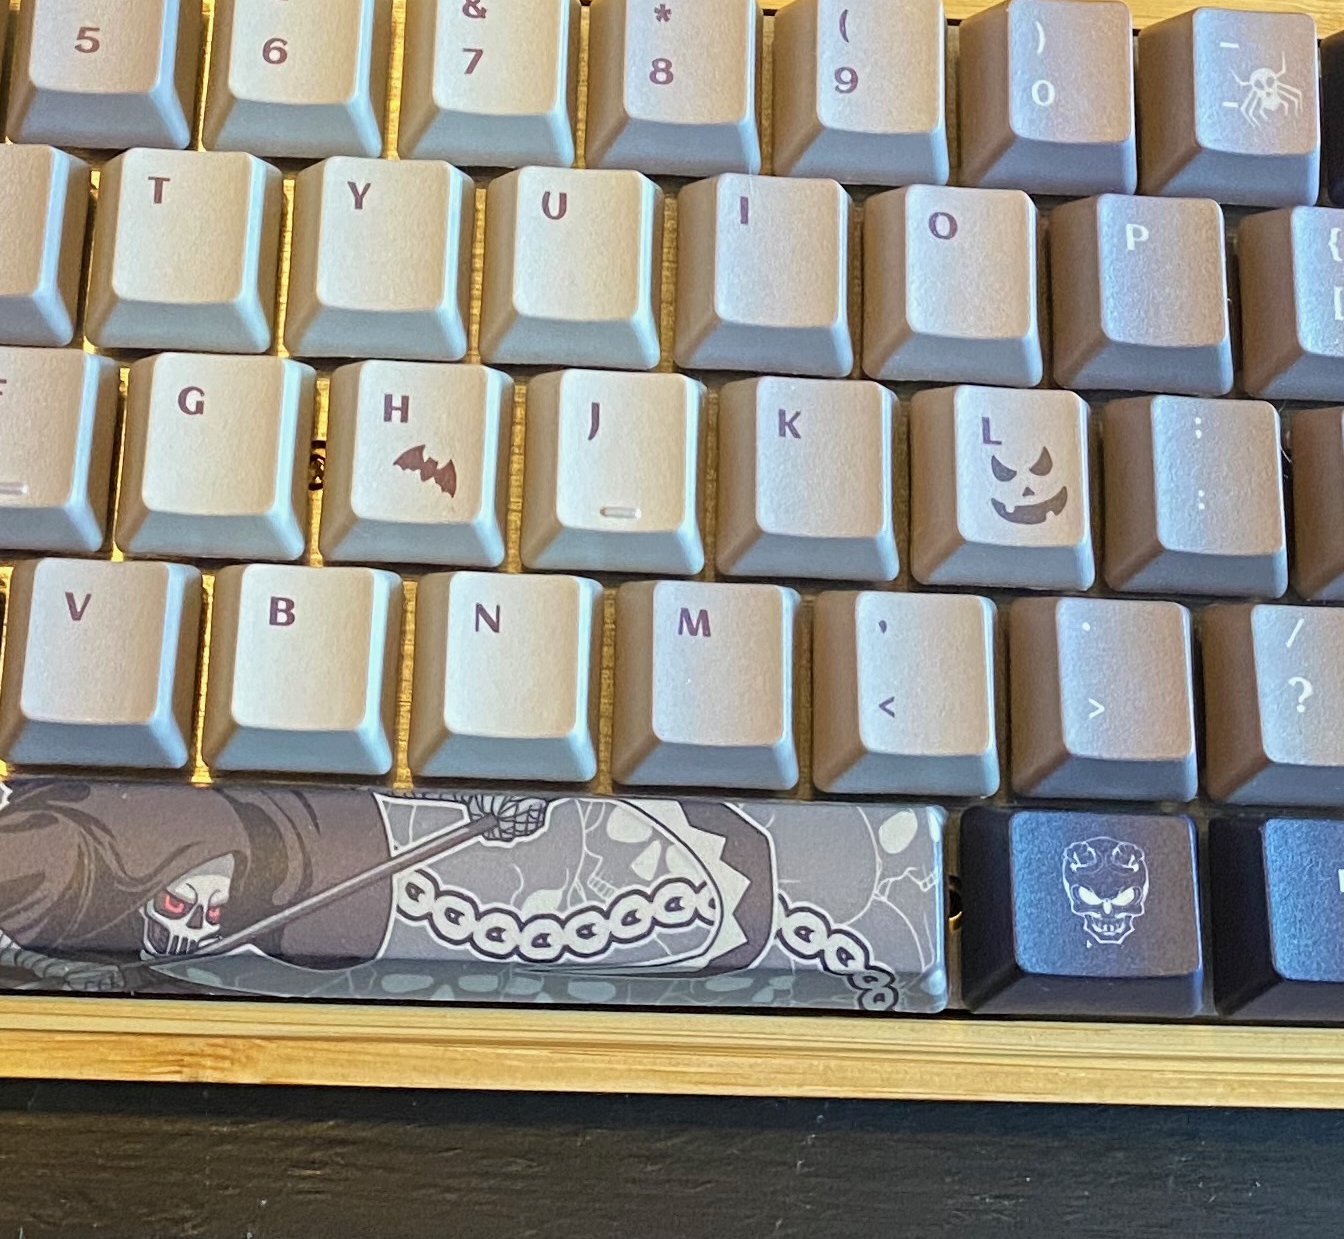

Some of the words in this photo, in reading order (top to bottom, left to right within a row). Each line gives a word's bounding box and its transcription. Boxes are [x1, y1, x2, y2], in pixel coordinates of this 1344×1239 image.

[74, 26, 101, 54] 5
[839, 9, 850, 43] (
[1035, 21, 1046, 55] )
[262, 37, 288, 65] 6
[462, 47, 484, 75] 7
[649, 57, 674, 85] 8
[834, 66, 859, 94] 9
[147, 176, 171, 204] T
[347, 180, 372, 210] Y
[541, 191, 568, 221] U
[928, 211, 958, 241] O
[1125, 223, 1150, 251] P
[1327, 227, 1343, 262] {
[1333, 285, 1344, 321] [
[177, 385, 205, 416] G
[383, 393, 410, 424] H
[587, 401, 601, 441] J
[778, 408, 802, 440] K
[981, 416, 1003, 446] L
[64, 591, 92, 622] V
[268, 596, 296, 627] B
[475, 602, 501, 634] N
[678, 607, 712, 638] M
[1285, 618, 1305, 648] /
[878, 696, 896, 719] <
[1088, 697, 1105, 720] >
[1287, 676, 1313, 713] ?
